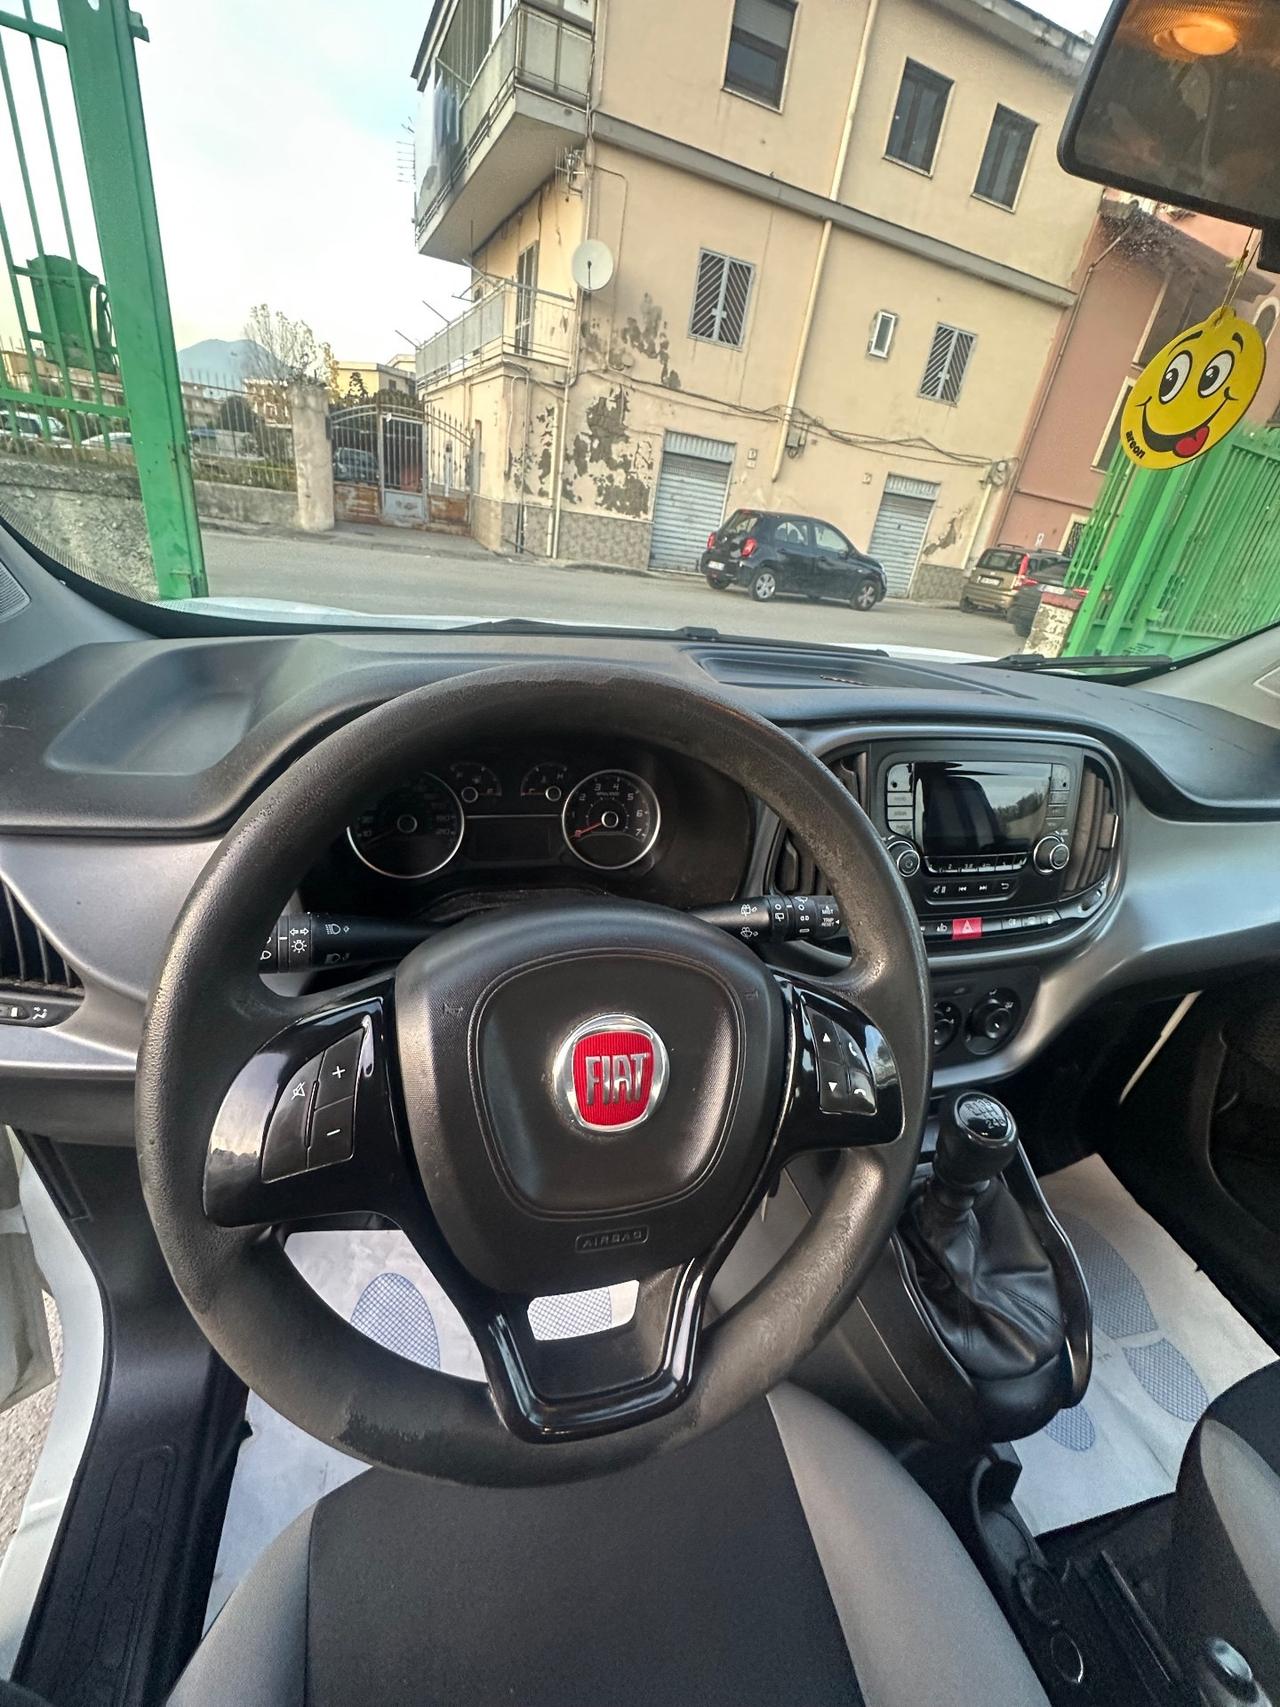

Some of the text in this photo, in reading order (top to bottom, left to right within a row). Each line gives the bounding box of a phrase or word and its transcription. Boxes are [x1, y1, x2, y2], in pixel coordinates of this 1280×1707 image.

[1125, 430, 1146, 459] areon
[585, 1052, 650, 1106] FIAT
[582, 1230, 642, 1248] AIRBAG
